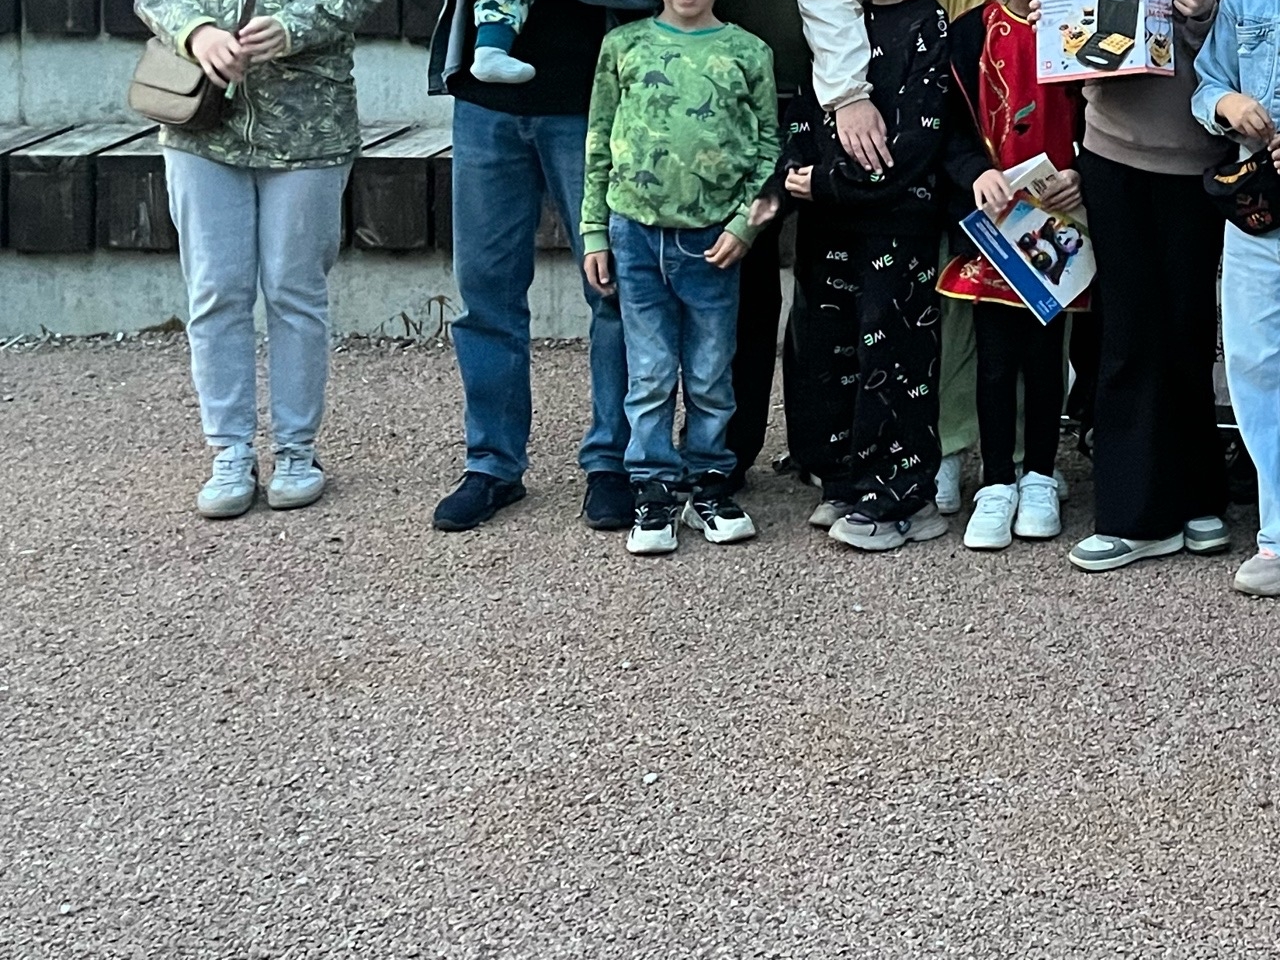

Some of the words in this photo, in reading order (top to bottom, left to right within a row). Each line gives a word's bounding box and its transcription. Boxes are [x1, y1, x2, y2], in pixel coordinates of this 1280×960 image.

[921, 115, 941, 130] WE
[826, 250, 849, 262] ARE
[871, 253, 895, 271] WE
[1045, 297, 1059, 311] 12
[863, 329, 887, 347] WE
[907, 383, 930, 399] WE
